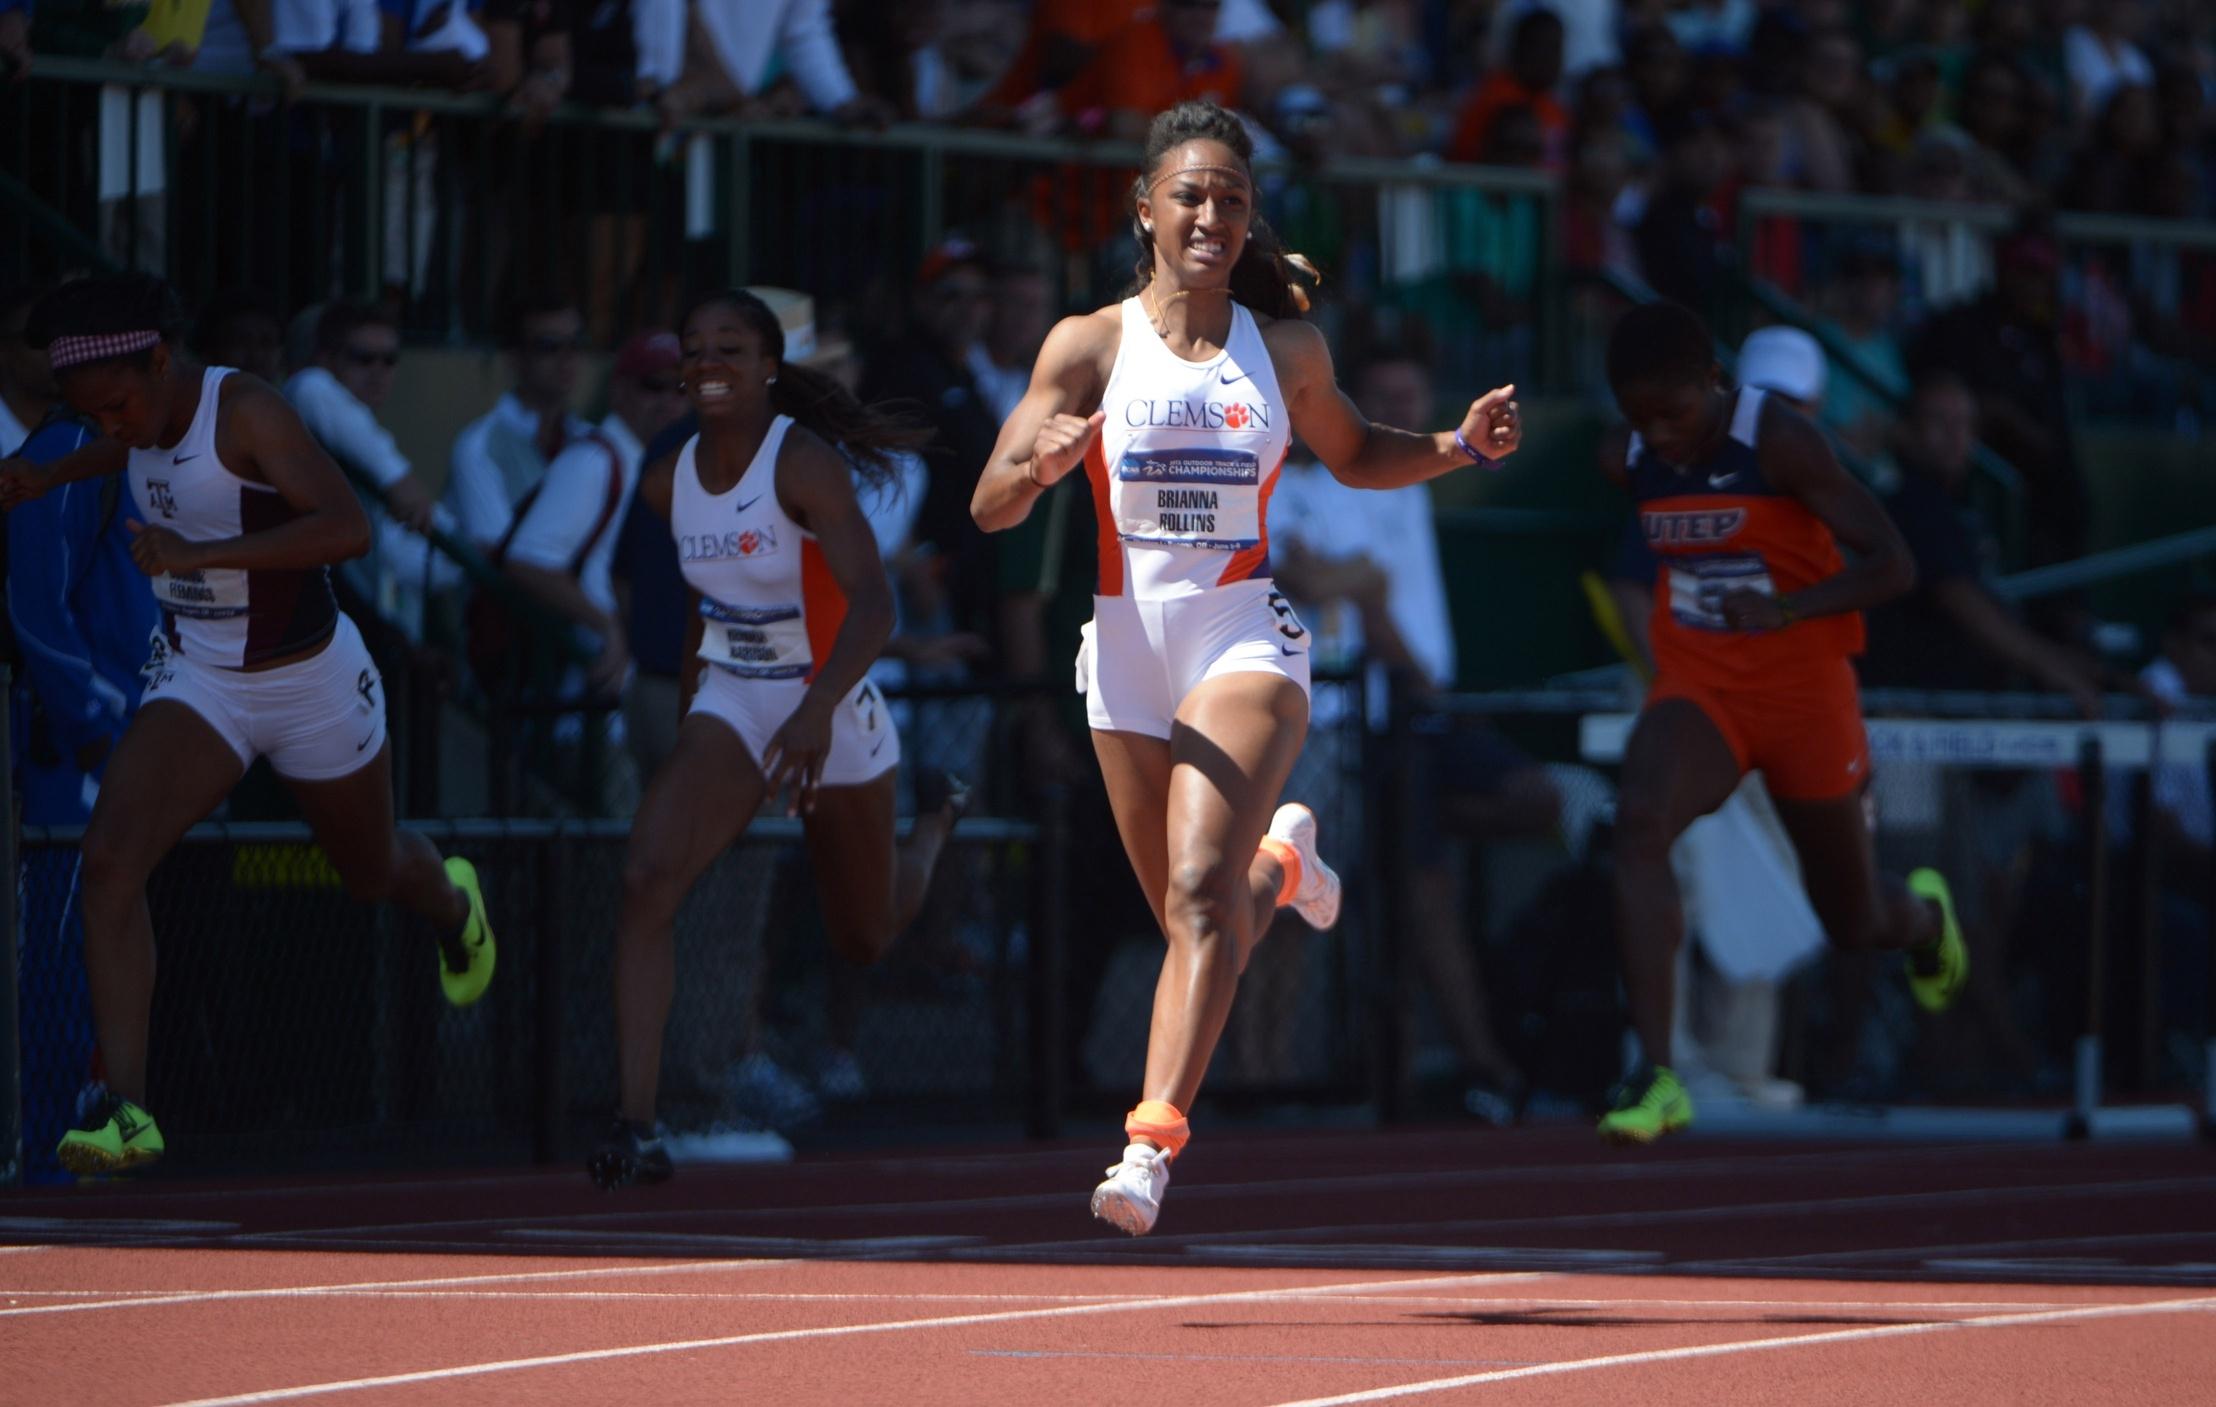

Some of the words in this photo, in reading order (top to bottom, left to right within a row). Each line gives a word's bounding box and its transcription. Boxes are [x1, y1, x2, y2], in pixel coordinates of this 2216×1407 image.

[1168, 466, 1256, 478] CHAMPIONSHIPS
[1157, 489, 1218, 510] BRIANNA
[1159, 512, 1215, 533] ROLLINS
[1642, 508, 1747, 544] UTEP
[1268, 592, 1304, 639] 5
[856, 684, 876, 731] 7
